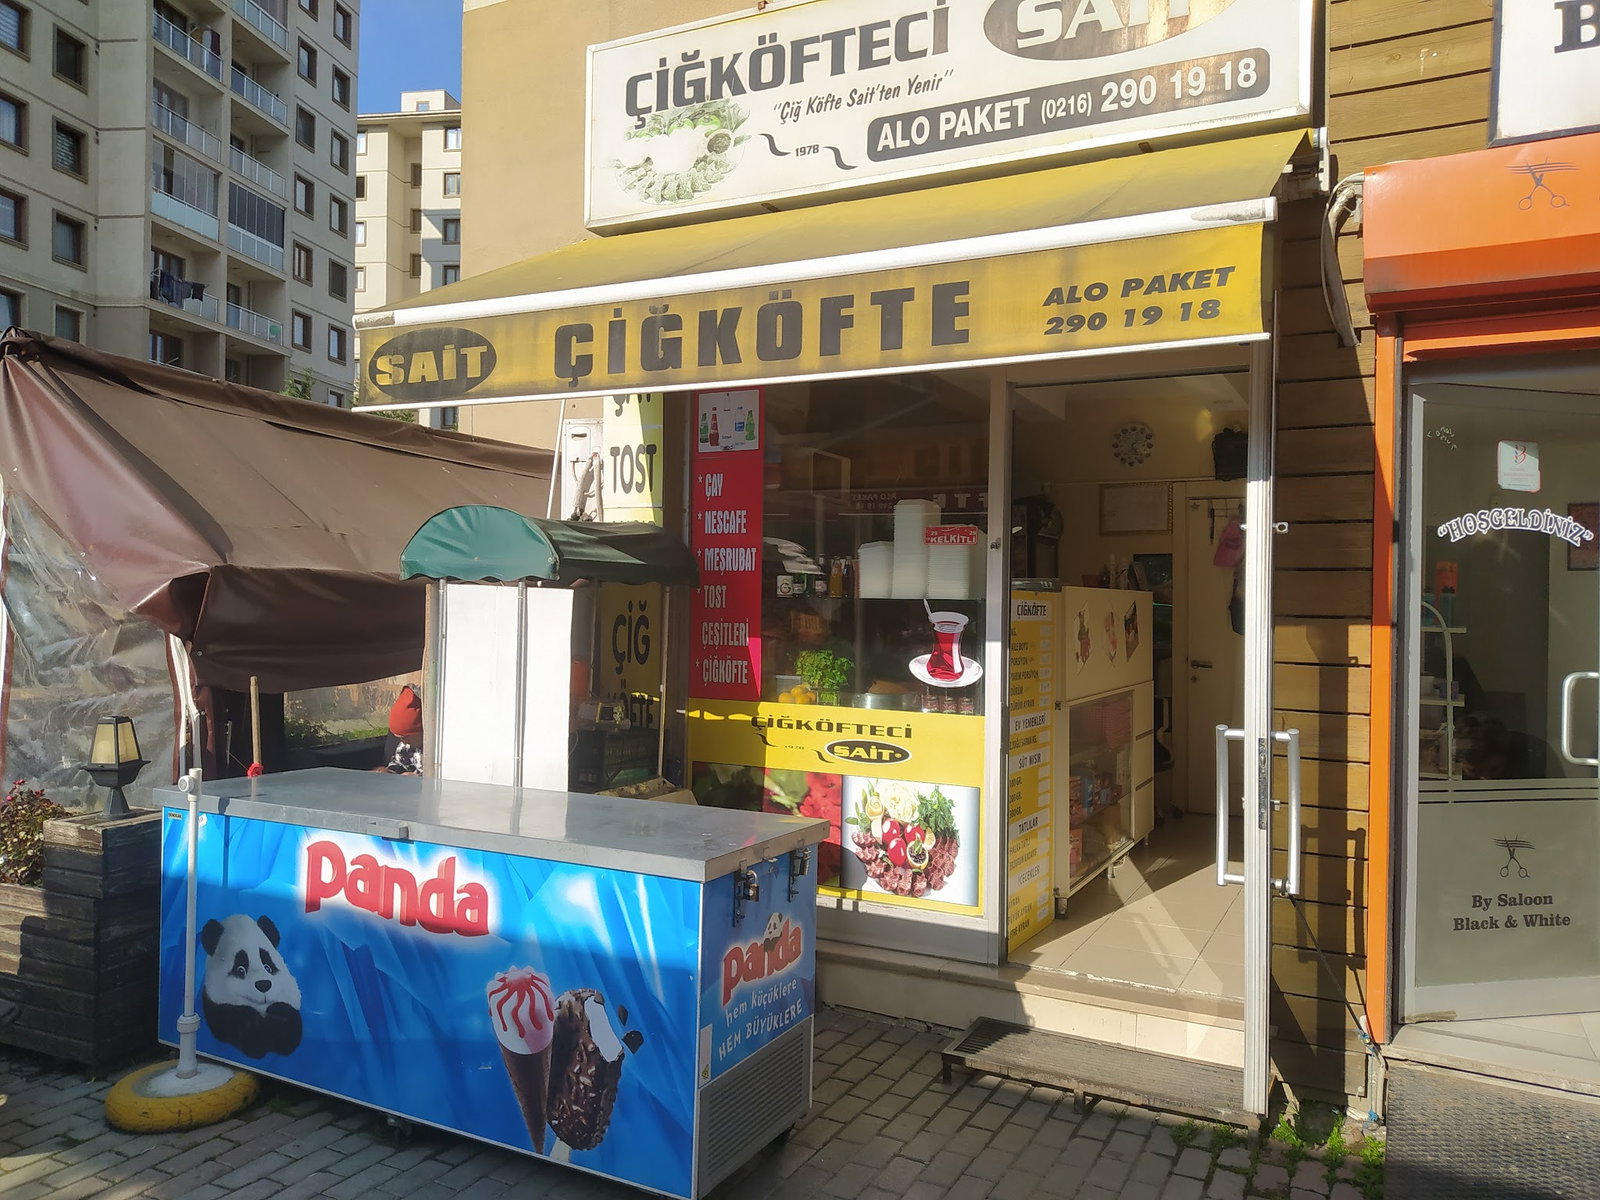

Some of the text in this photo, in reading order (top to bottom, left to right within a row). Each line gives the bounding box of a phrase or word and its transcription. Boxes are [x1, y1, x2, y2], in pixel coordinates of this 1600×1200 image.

[626, 0, 950, 130] ÇİĞKÖFTECİ
[806, 93, 842, 116] Köfte
[876, 57, 1257, 152] ALO PAKET (0216) 290 19 18
[795, 144, 820, 157] 1978
[1043, 266, 1236, 306] ALO PAKET
[554, 281, 971, 388] ÇİĞKÖFTE
[1044, 300, 1222, 336] 290 19 18
[376, 344, 488, 386] SAİT
[610, 443, 657, 494] TOST
[705, 473, 724, 501] ÇAY
[705, 510, 747, 534] NESCAFE
[704, 548, 756, 575] MEŞRUBAT
[703, 585, 727, 608] TOST
[612, 600, 650, 675] ÇİĞ
[702, 618, 749, 649] ÇEŞİTLERİ
[702, 655, 748, 686] ÇİĞKÖFTE
[751, 714, 913, 739] ÇİĞKÖFTECİ
[832, 745, 896, 761] SAİT
[305, 840, 490, 937] panda
[1472, 893, 1553, 911] By Saloon
[1453, 914, 1571, 931] Black & White
[722, 917, 802, 1007] panda
[725, 977, 797, 1027] hem küçüklere
[719, 999, 803, 1061] HEM BÜYÜKLERE
